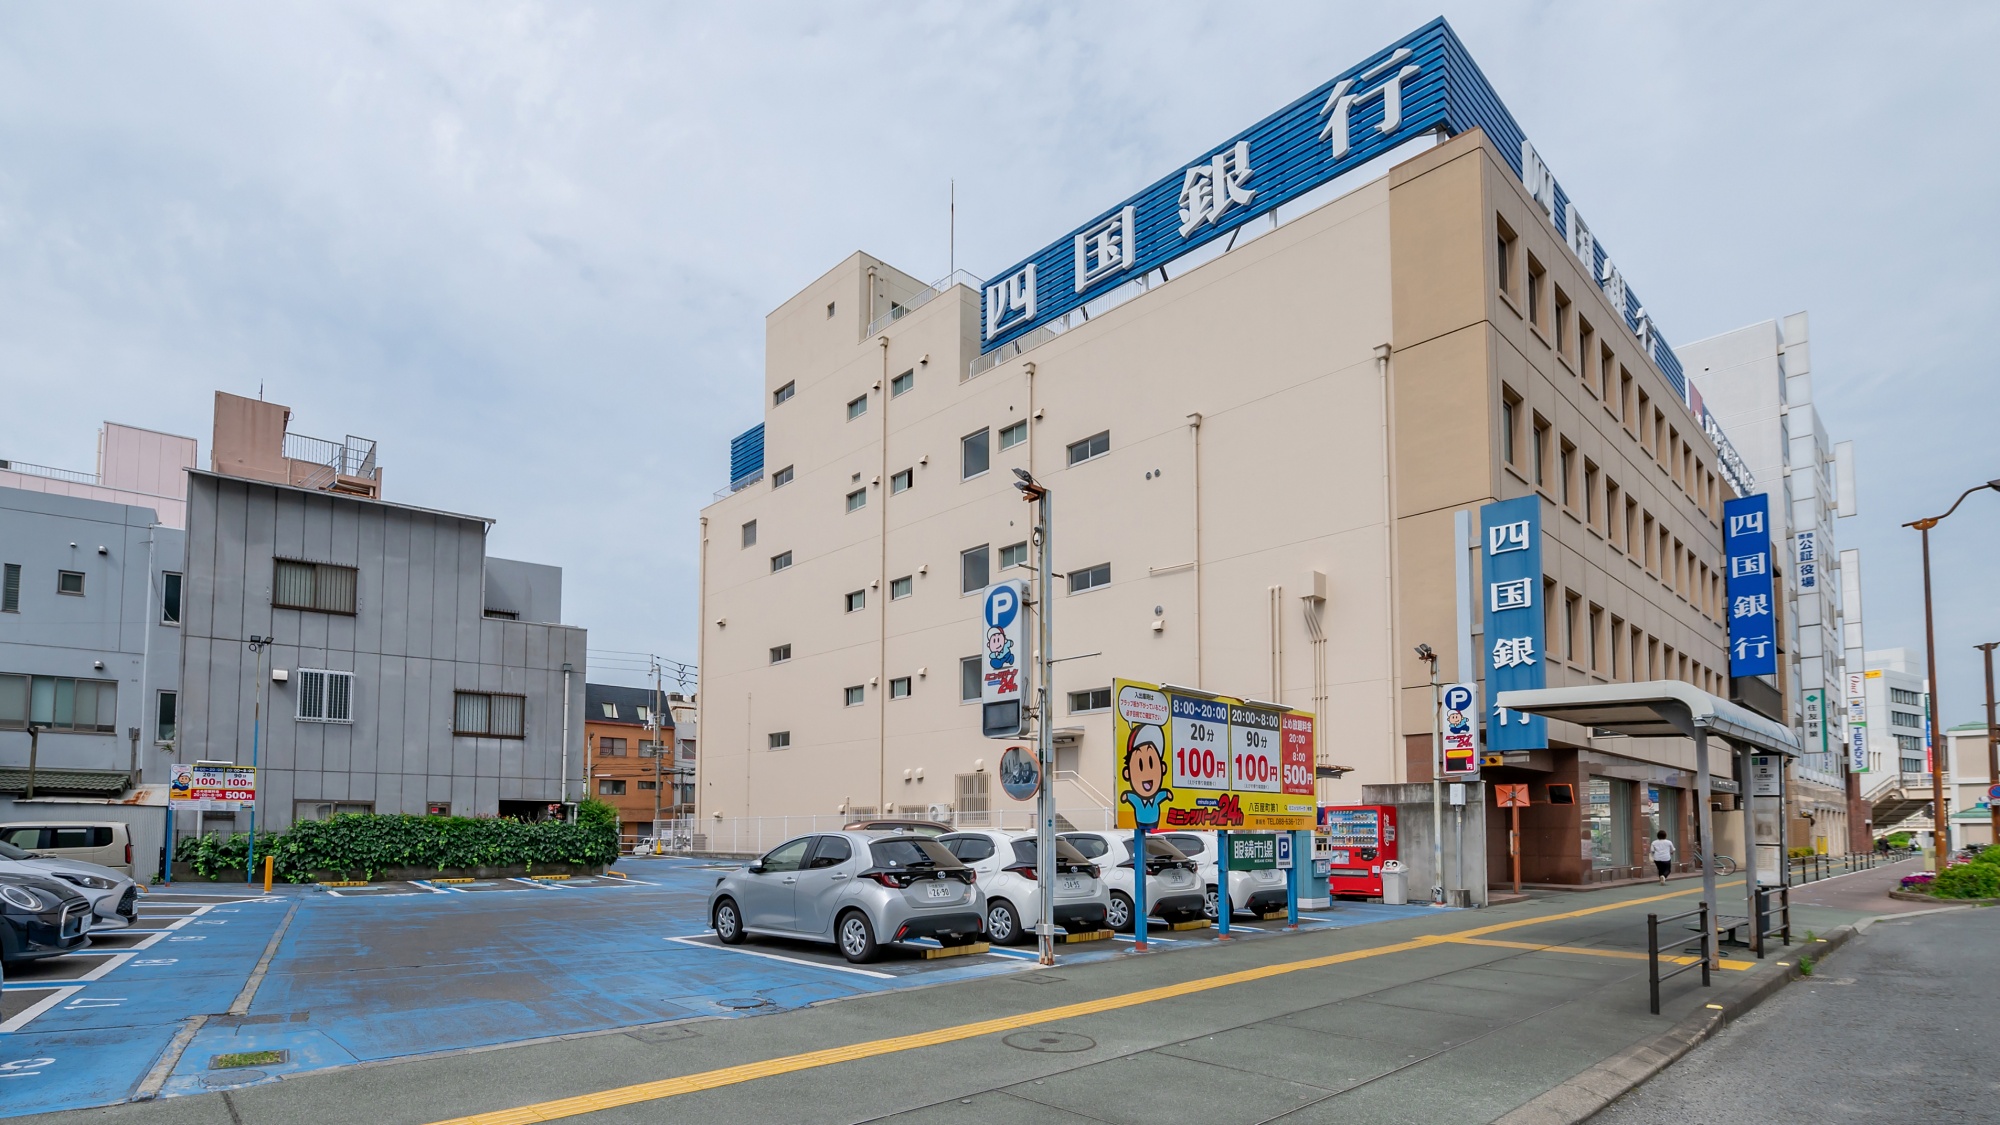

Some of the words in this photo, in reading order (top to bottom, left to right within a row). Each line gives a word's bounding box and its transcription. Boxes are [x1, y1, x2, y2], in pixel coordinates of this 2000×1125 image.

[986, 47, 1422, 341] 四国銀行
[1799, 540, 1815, 588] 公証役場
[1730, 511, 1771, 660] 四国銀行
[992, 592, 1013, 625] P
[1450, 690, 1468, 709] P
[1190, 723, 1215, 742] 20分
[1282, 717, 1312, 732] 止め放題料金
[1246, 730, 1268, 748] 90分
[1288, 733, 1306, 744] 20:00
[1177, 747, 1226, 779] 100円
[1292, 752, 1306, 762] 8:00
[1235, 753, 1278, 783] 100円
[1283, 764, 1313, 785] 500円
[225, 791, 253, 799] 500円
[1234, 840, 1274, 858] 眼鏡市場
[1280, 841, 1288, 857] P
